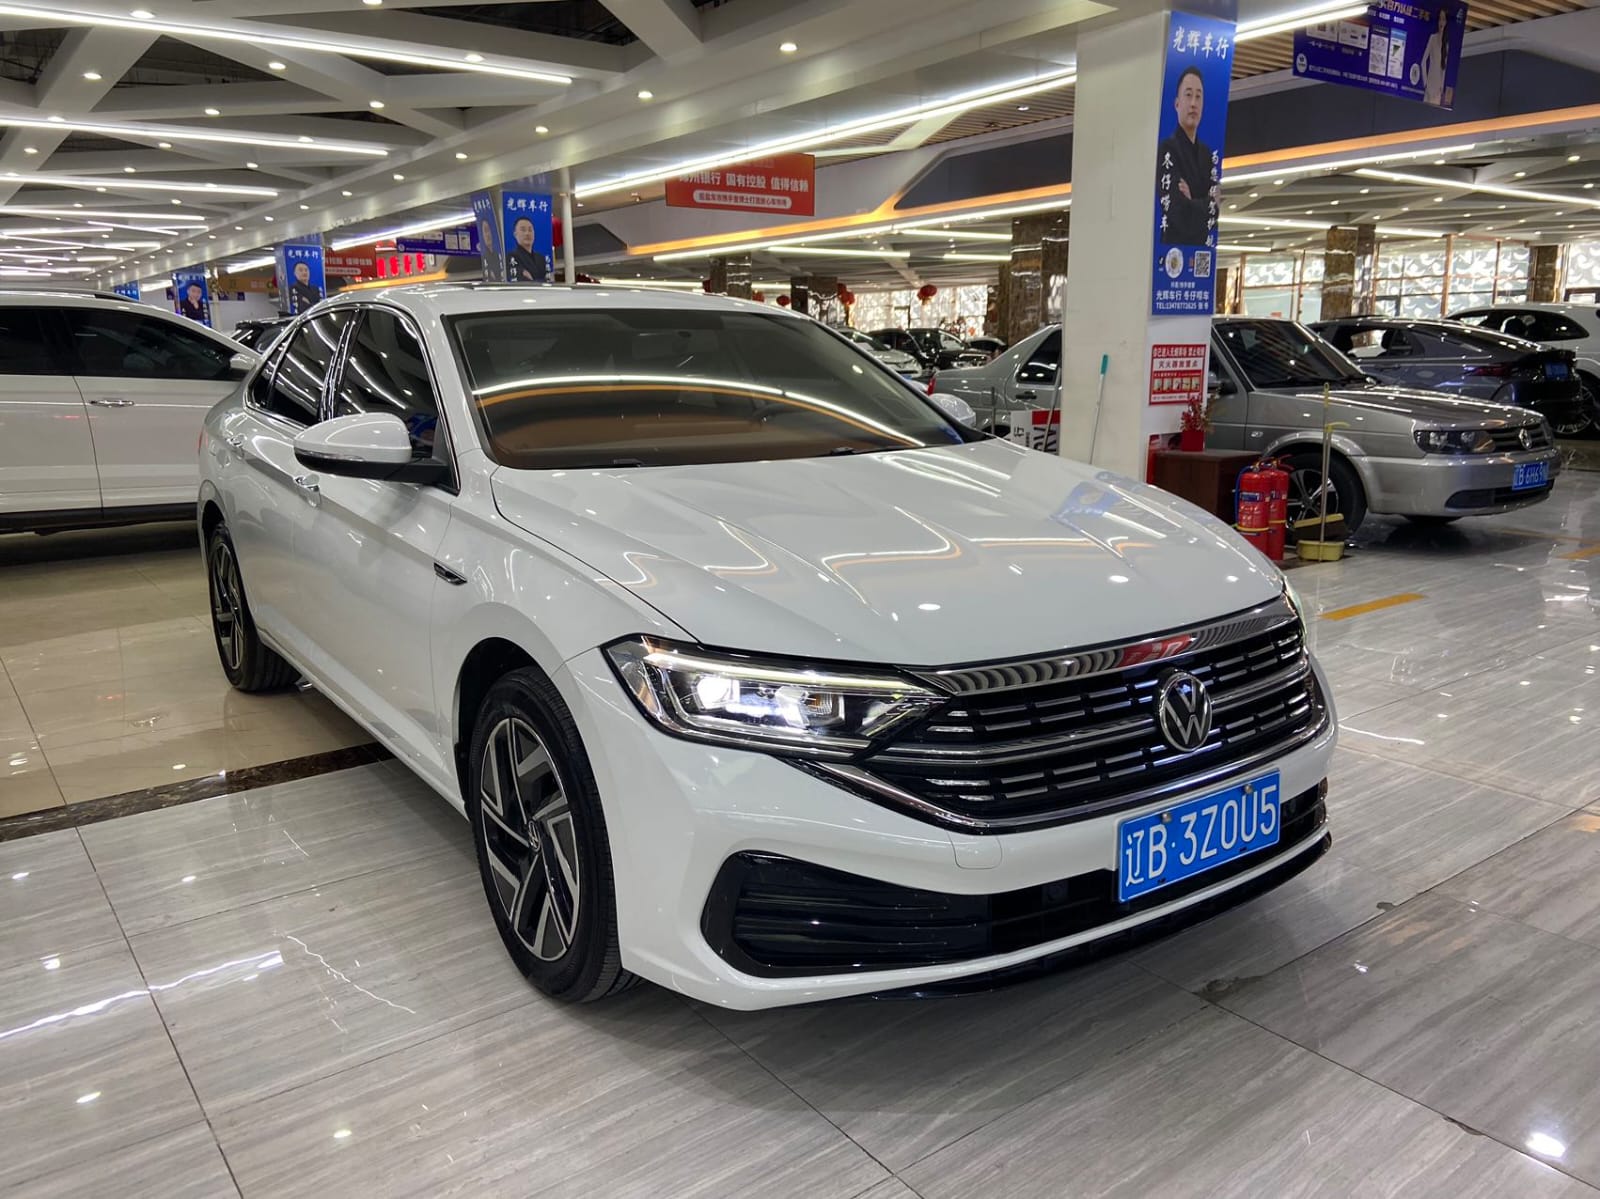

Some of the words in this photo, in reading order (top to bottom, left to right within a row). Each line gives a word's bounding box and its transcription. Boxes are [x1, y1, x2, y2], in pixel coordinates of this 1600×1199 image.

[1172, 25, 1230, 60] 光辉车行
[726, 172, 766, 189] 国有控股
[771, 176, 809, 193] 值得信赖
[507, 197, 549, 213] 光辉车行
